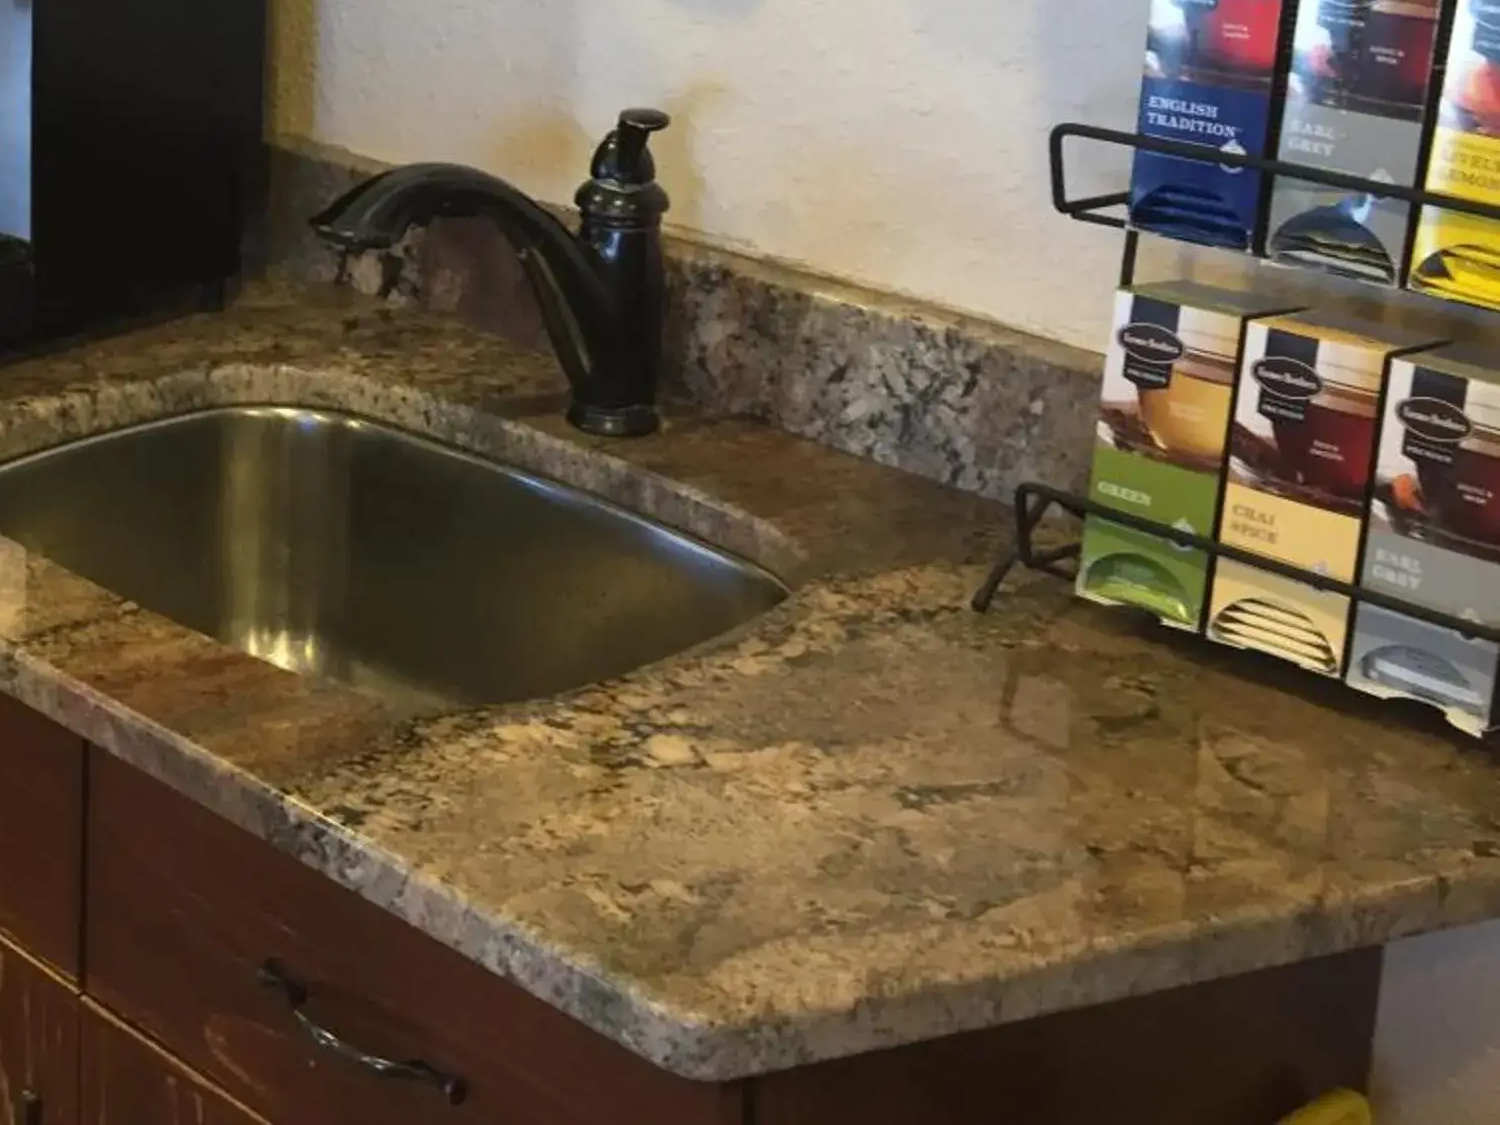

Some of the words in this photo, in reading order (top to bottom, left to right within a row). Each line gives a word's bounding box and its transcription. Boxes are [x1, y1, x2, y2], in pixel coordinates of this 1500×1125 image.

[1147, 96, 1219, 118] ENGLISH
[1097, 480, 1152, 507] GREEN
[1232, 503, 1276, 526] CHAI
